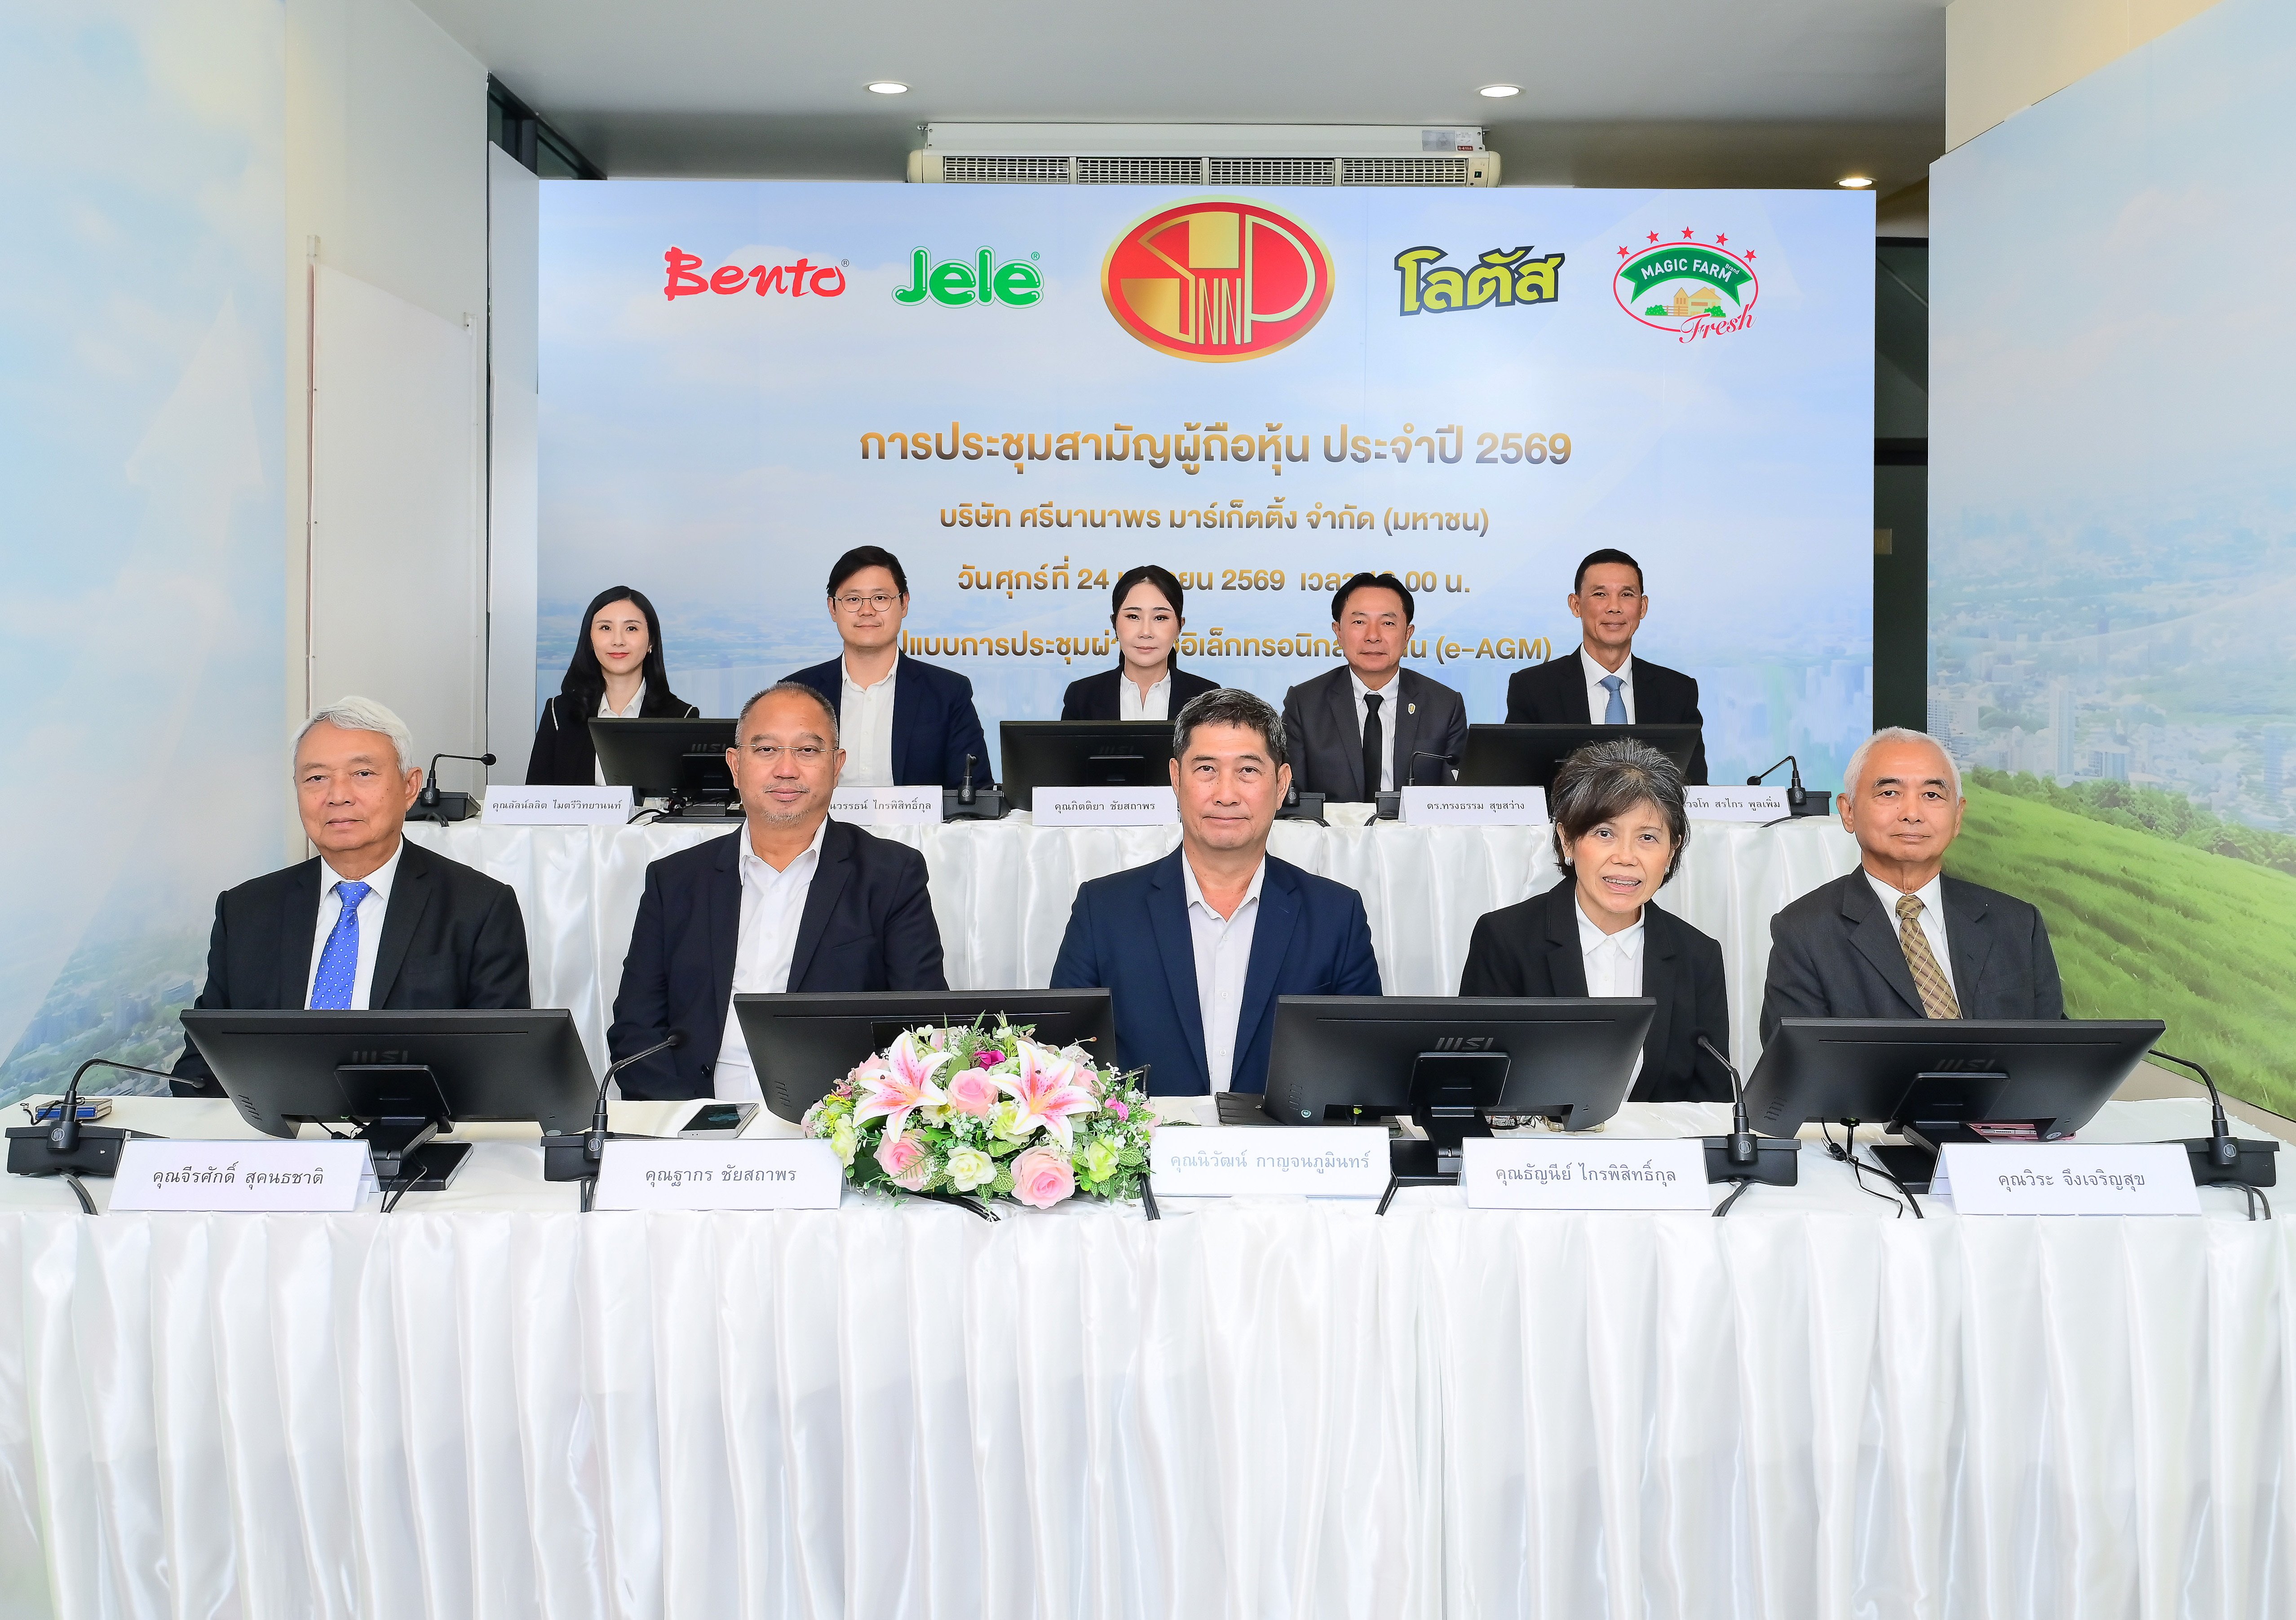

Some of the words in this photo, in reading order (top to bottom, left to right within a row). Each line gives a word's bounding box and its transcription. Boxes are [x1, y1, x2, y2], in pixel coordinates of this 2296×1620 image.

[1395, 246, 1565, 316] โลตัส
[1641, 258, 1688, 280] MAGIC
[1693, 259, 1732, 283] FARM
[1725, 263, 1740, 275] Brand
[1679, 304, 1757, 344] Fresh
[860, 421, 1310, 476] การประชุมสามัญผู้ถือหุ้น
[1324, 423, 1464, 464] ประจำปี
[1476, 433, 1571, 464] 2569
[940, 502, 1011, 528] บริษัท
[1021, 500, 1161, 528] ศรีนานาพร
[1170, 496, 1297, 529] มาร์เก็ตติ้ง
[1307, 502, 1375, 530] จำกัด
[1384, 507, 1489, 537] (มหาชน)
[1077, 568, 1110, 590] 24
[1221, 569, 1286, 591] 2569
[1445, 574, 1470, 593] น.
[1436, 636, 1552, 665] (e-AGM)
[553, 799, 622, 810] ไมตรีวิทยานนท์
[830, 799, 868, 810] นวรรธน์
[873, 797, 931, 813] ไกรพิสิทธิ์กุล
[1055, 801, 1105, 814] คุณกิตติยา
[1110, 801, 1155, 810] ชัยสถาพร
[1490, 800, 1525, 813] สุขสว่าง
[1715, 798, 1743, 808] สรไกร
[1748, 796, 1780, 811] พูลเพิ่ม
[1171, 1150, 1248, 1173] คุณนิวัฒน์
[1256, 1150, 1371, 1174] กาญจนภูมินทร์
[1496, 1163, 1573, 1187] คุณธัญนีย์
[1578, 1159, 1677, 1187] ไกรพิสิทธิ์กุล
[153, 1161, 239, 1189] คุณจีรศักดิ์
[245, 1168, 324, 1190] สุคนธชาติ
[646, 1170, 713, 1188] คุณฐากร
[721, 1165, 797, 1182] ชัยสถาพร
[1999, 1169, 2055, 1192] คุณวิระ
[2062, 1169, 2146, 1192] จึงเจริญสุข
